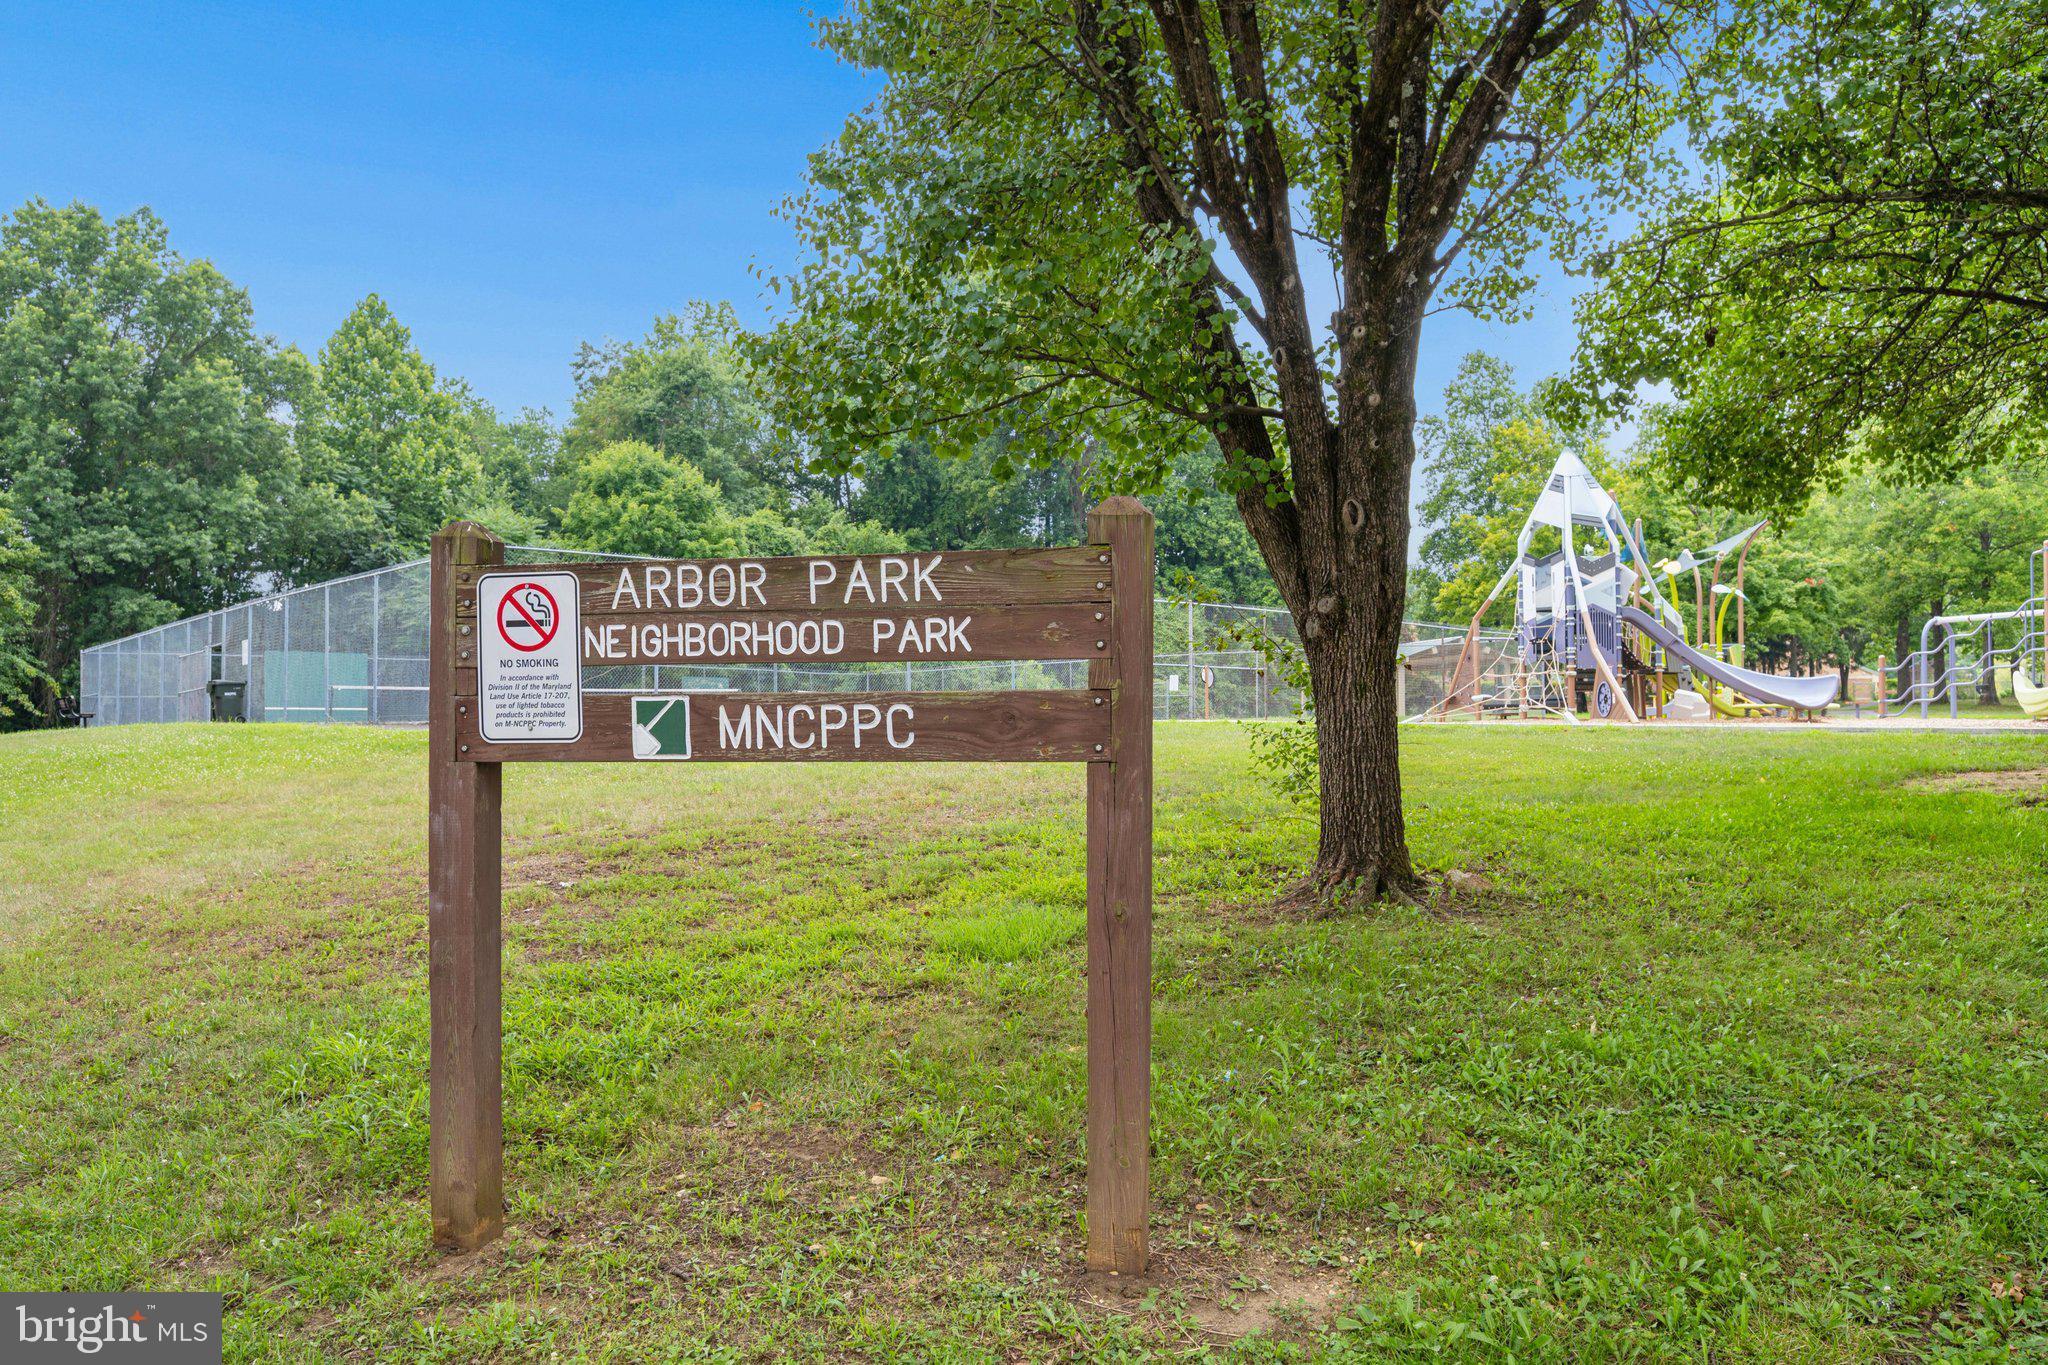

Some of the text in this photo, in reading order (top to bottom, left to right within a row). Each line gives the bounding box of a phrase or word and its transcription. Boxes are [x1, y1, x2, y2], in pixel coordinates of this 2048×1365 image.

[612, 555, 943, 609] ARBOR PARK
[585, 616, 972, 659] NEIGHBORHOOD PARK
[500, 658, 559, 668] NO SMOKING
[542, 683, 572, 691] Maryland
[544, 692, 570, 700] 17-207,
[517, 702, 538, 710] lighted
[532, 711, 565, 719] prohibited
[538, 720, 567, 728] Property.
[719, 704, 915, 749] MNCPPC
